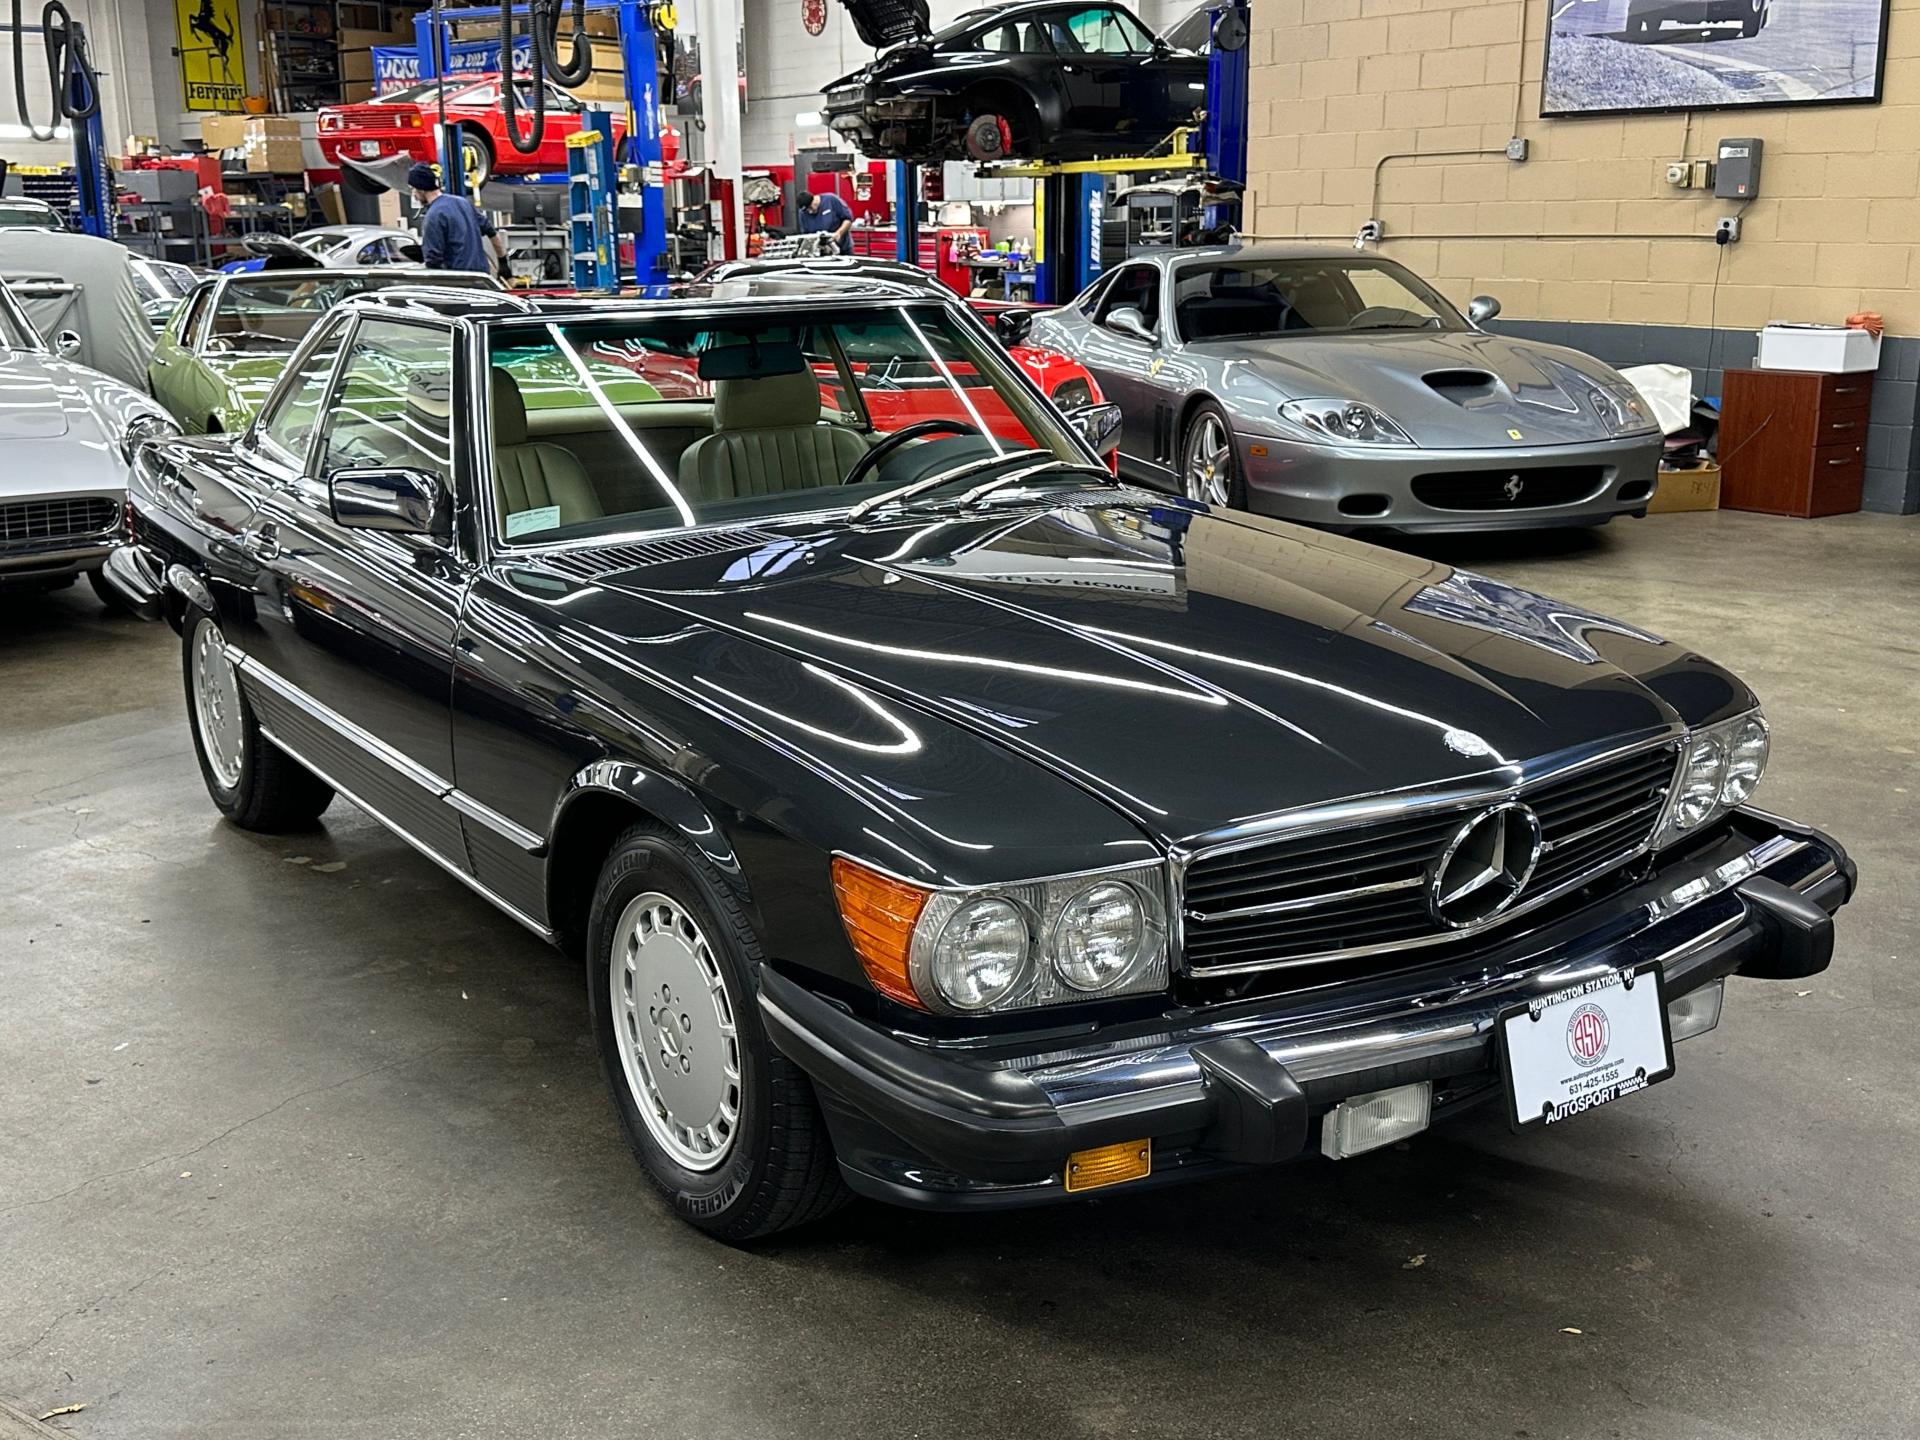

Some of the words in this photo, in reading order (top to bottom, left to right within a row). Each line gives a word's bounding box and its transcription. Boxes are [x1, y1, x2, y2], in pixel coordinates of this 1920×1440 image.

[1529, 985, 1584, 1012] HUNTINGTON
[1623, 968, 1635, 980] NY
[1575, 1014, 1602, 1057] ASD
[1569, 1069, 1619, 1095] 631-425-1555
[1545, 1086, 1617, 1124] AUTOSPORT
